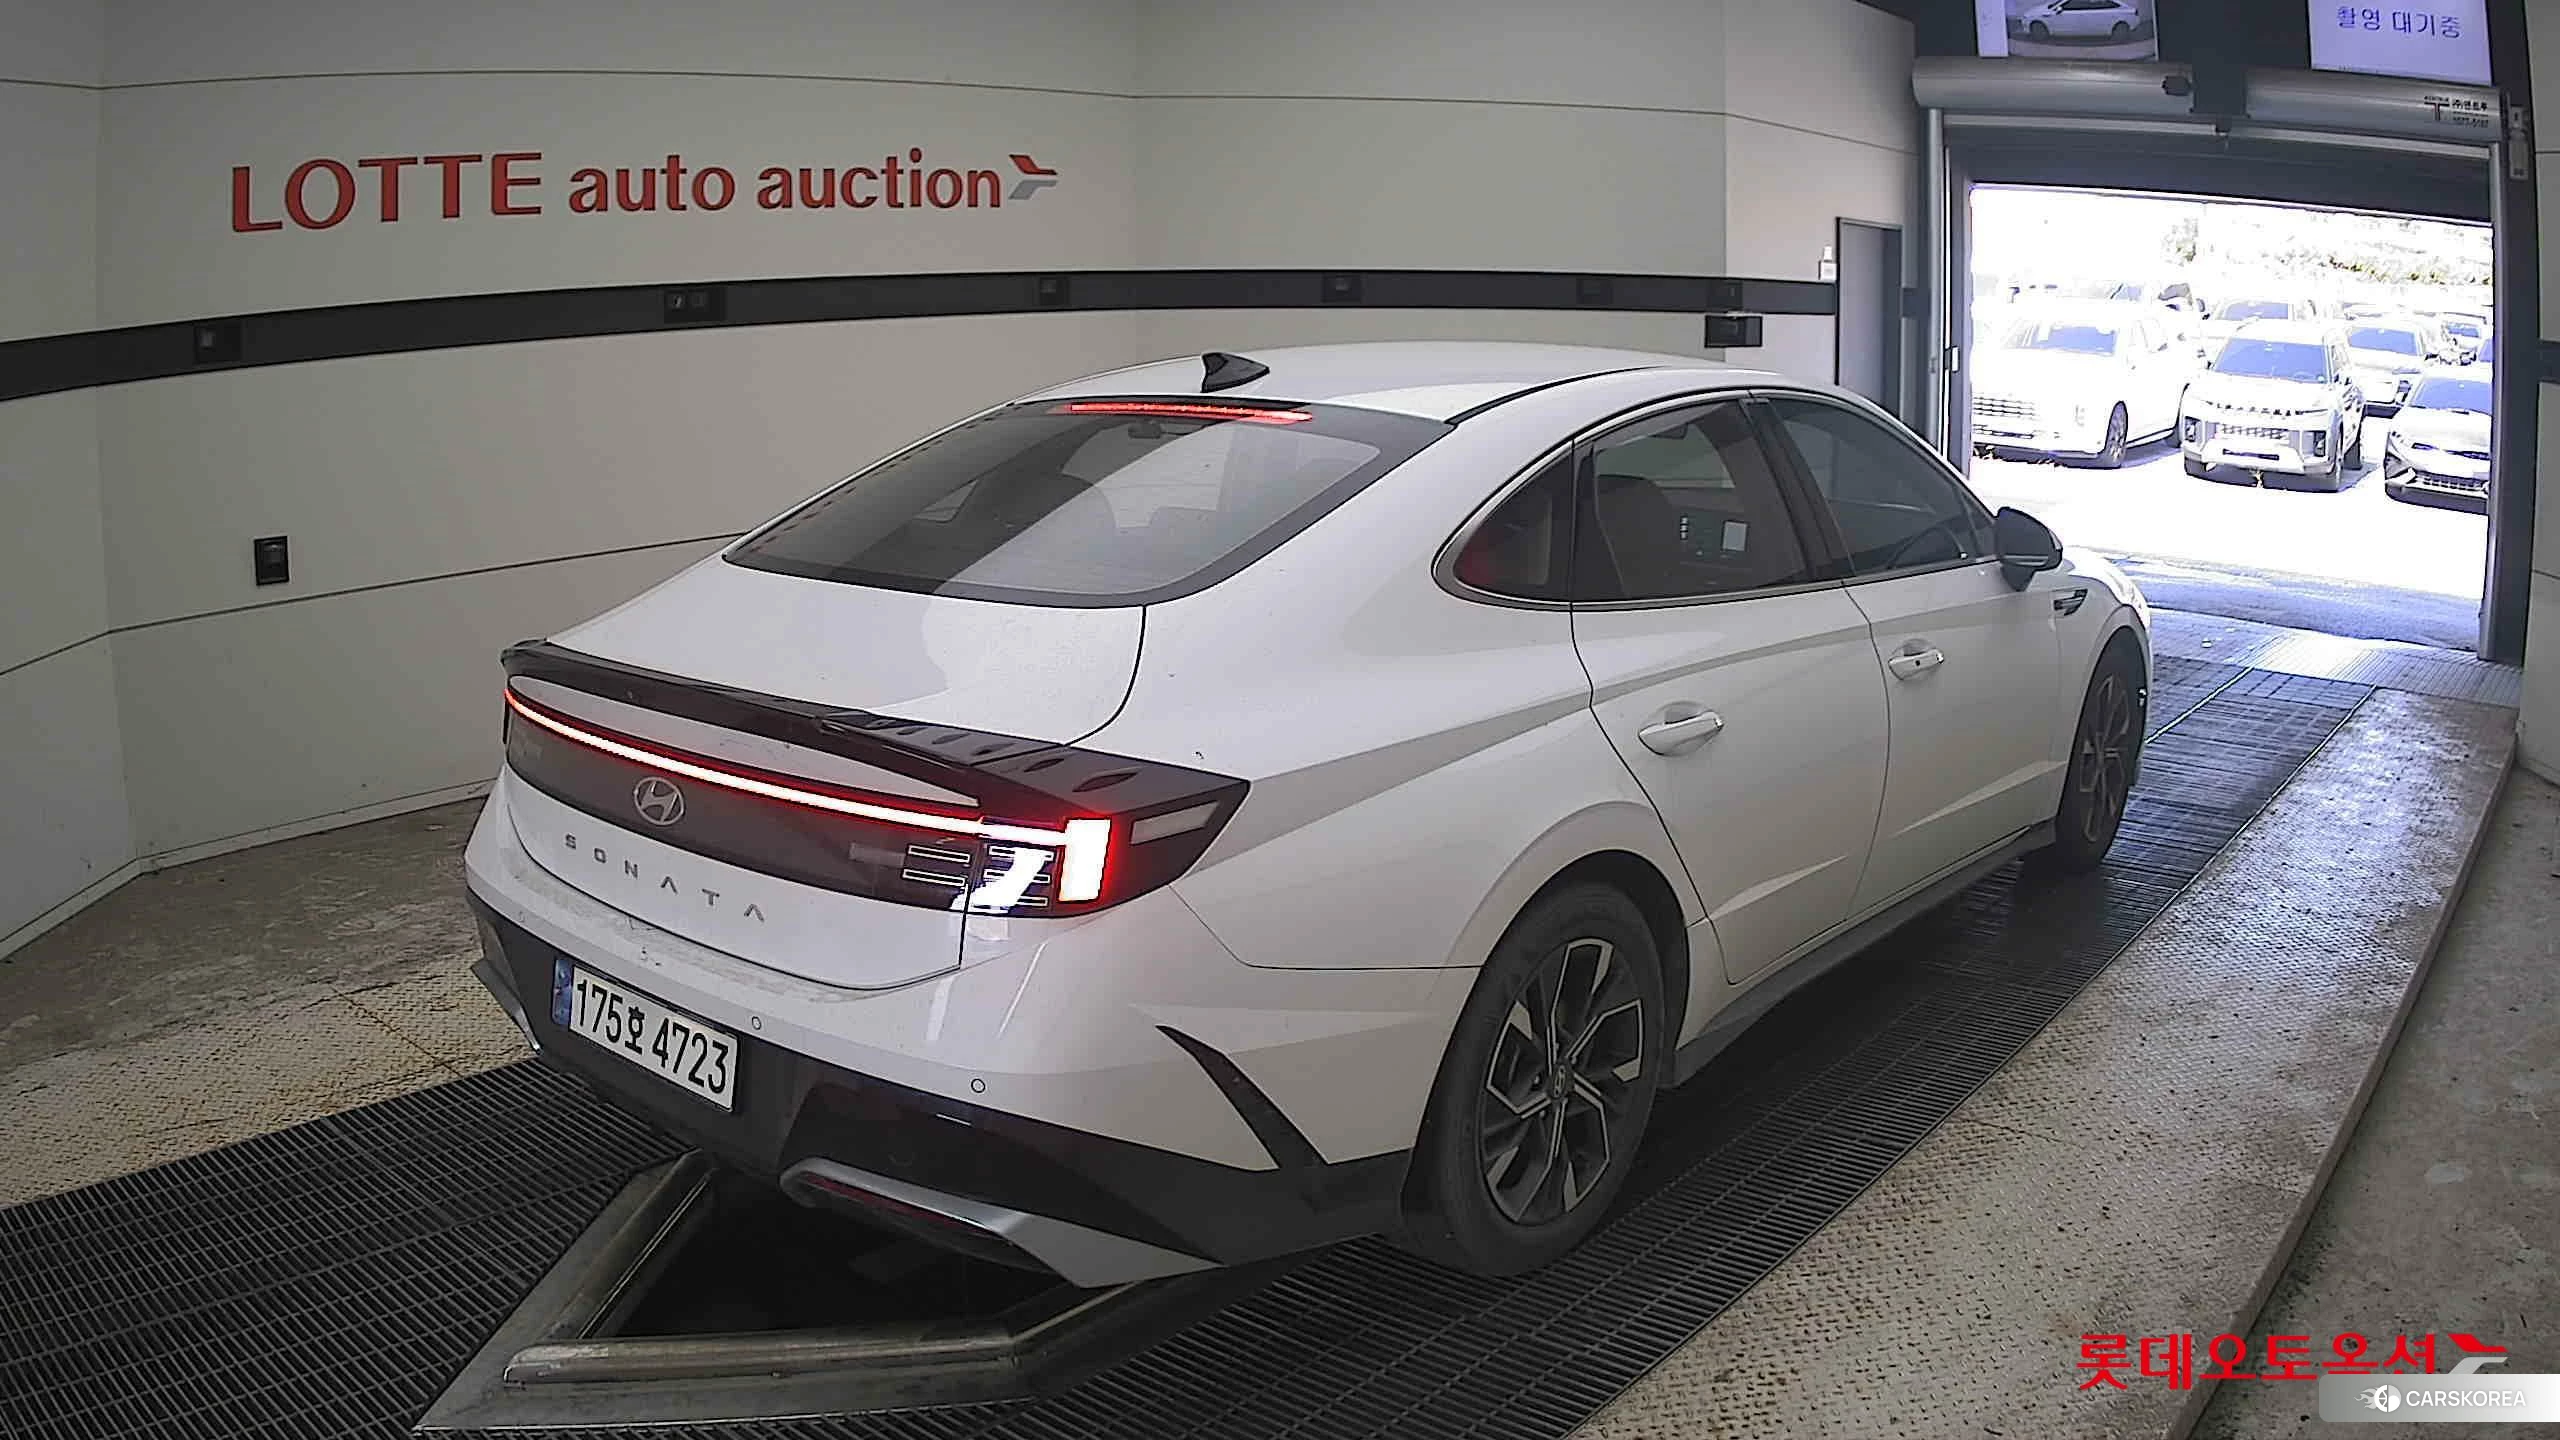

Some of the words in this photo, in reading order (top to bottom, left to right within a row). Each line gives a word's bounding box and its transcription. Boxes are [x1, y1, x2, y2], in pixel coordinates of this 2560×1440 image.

[2337, 6, 2381, 31] 촬영
[2392, 11, 2461, 39] 대기중
[232, 152, 542, 232] LOTTE
[568, 154, 735, 213] auto
[757, 147, 1001, 209] auction
[565, 833, 765, 923] SONATA
[652, 1017, 729, 1094] 4723
